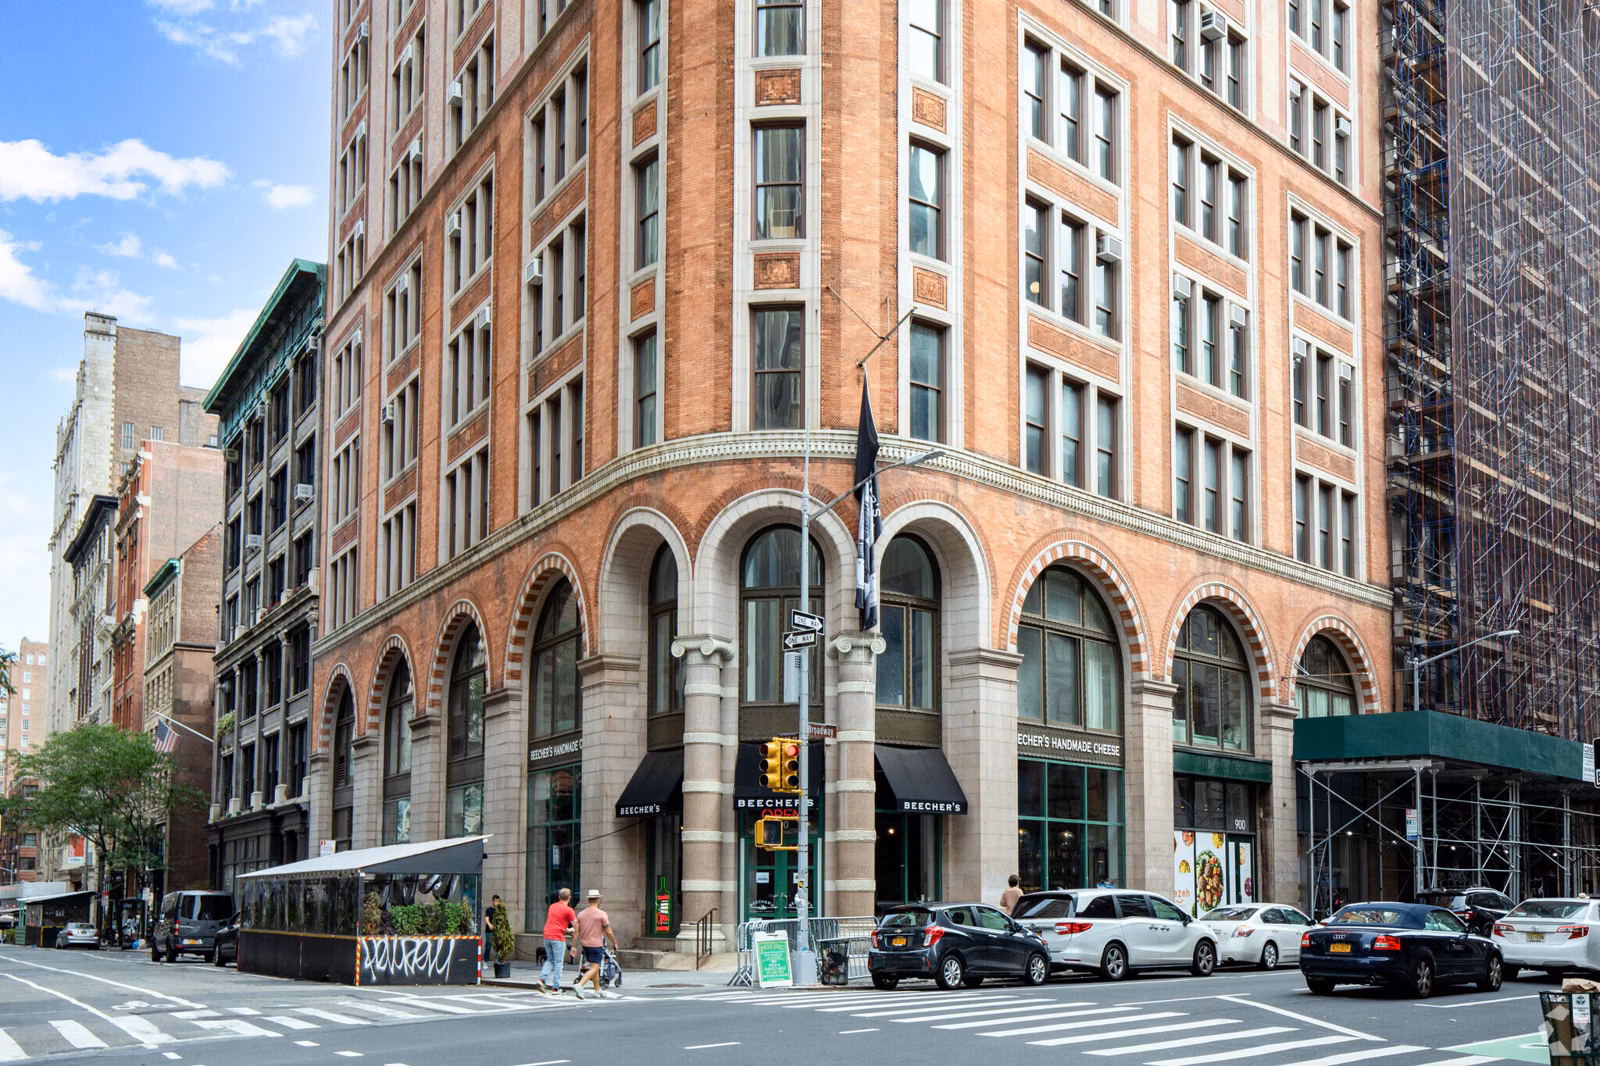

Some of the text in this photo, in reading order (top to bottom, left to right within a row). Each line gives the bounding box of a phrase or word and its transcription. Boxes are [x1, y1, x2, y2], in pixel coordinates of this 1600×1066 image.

[797, 616, 820, 628] ONE WAY
[788, 634, 813, 645] ONE WAY
[808, 725, 834, 738] Broadway
[530, 745, 553, 760] BEECHER'S
[554, 740, 579, 756] HANDMADE
[1052, 737, 1092, 752] HANDMADE
[1093, 743, 1120, 756] CHEESE
[738, 799, 814, 807] BEECHERS
[904, 801, 961, 812] BEECHER'S
[620, 804, 660, 815] BEECHER'S
[1235, 819, 1246, 830] 900
